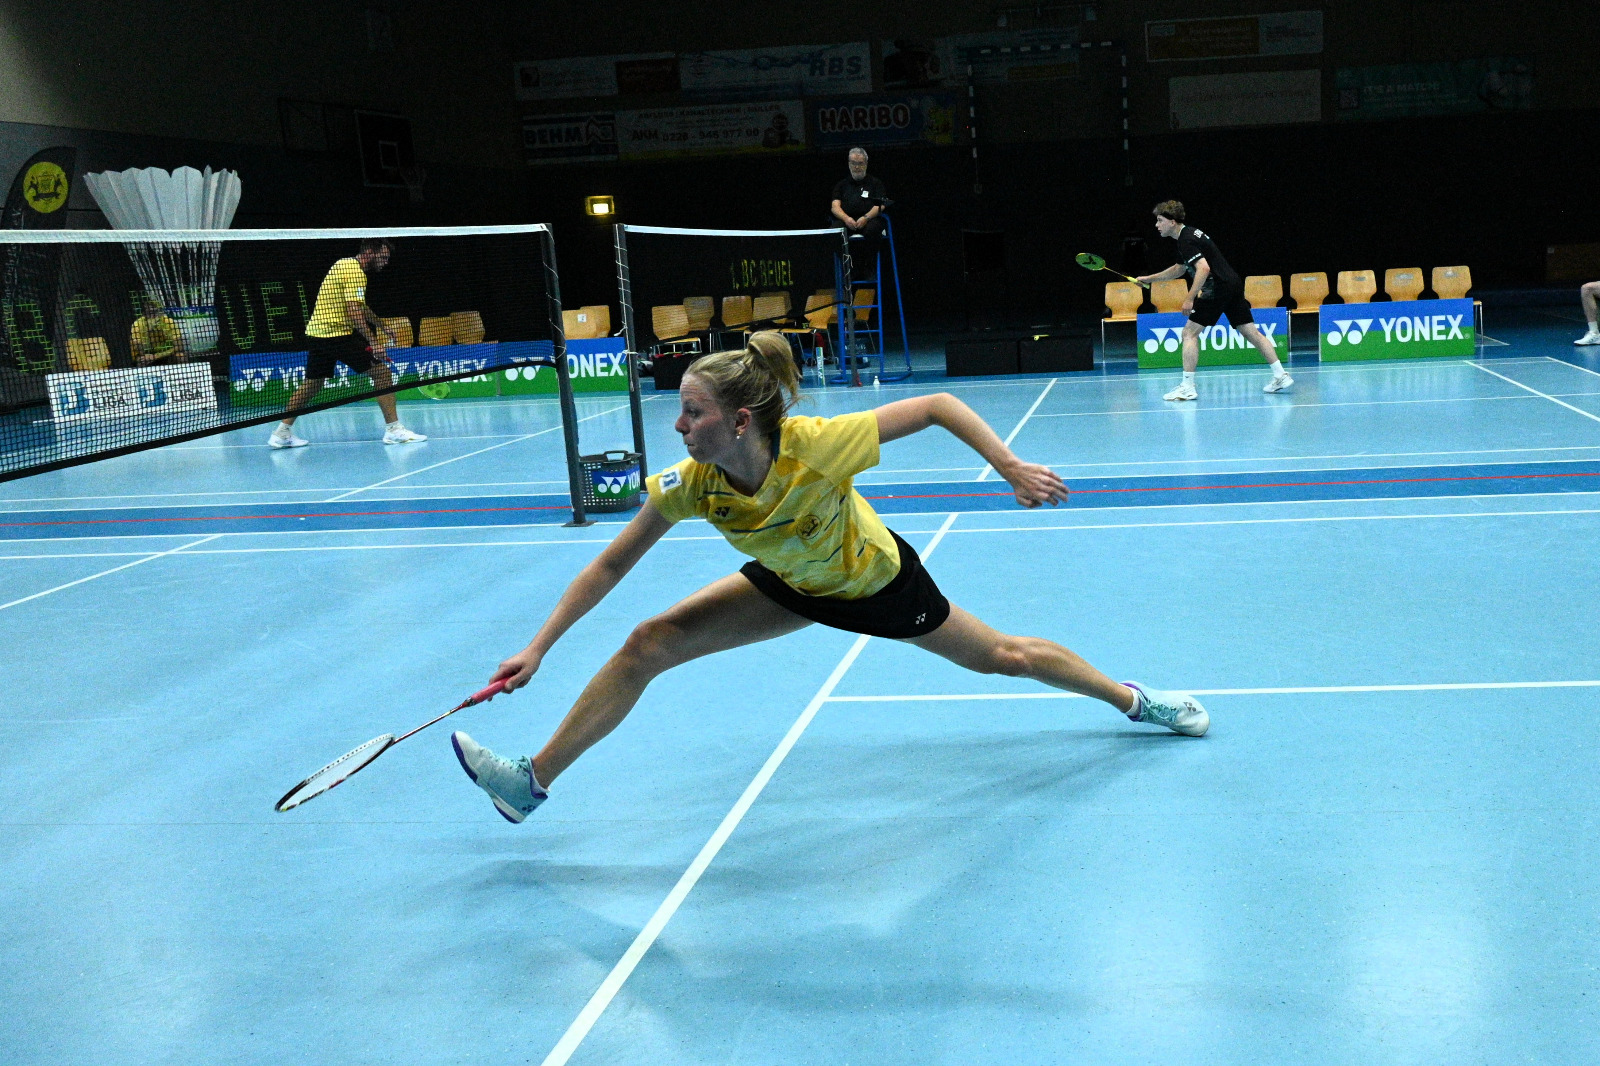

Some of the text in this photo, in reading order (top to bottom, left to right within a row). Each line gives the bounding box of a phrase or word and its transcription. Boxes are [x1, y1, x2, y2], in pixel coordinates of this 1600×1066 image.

[809, 56, 859, 77] RBS
[819, 102, 910, 134] HARIBO
[525, 126, 585, 146] BEHM
[631, 129, 659, 142] AKM
[1379, 314, 1464, 343] YONEX
[279, 364, 350, 391] YOX
[414, 358, 489, 383] YONEX
[550, 352, 627, 380] ONEX
